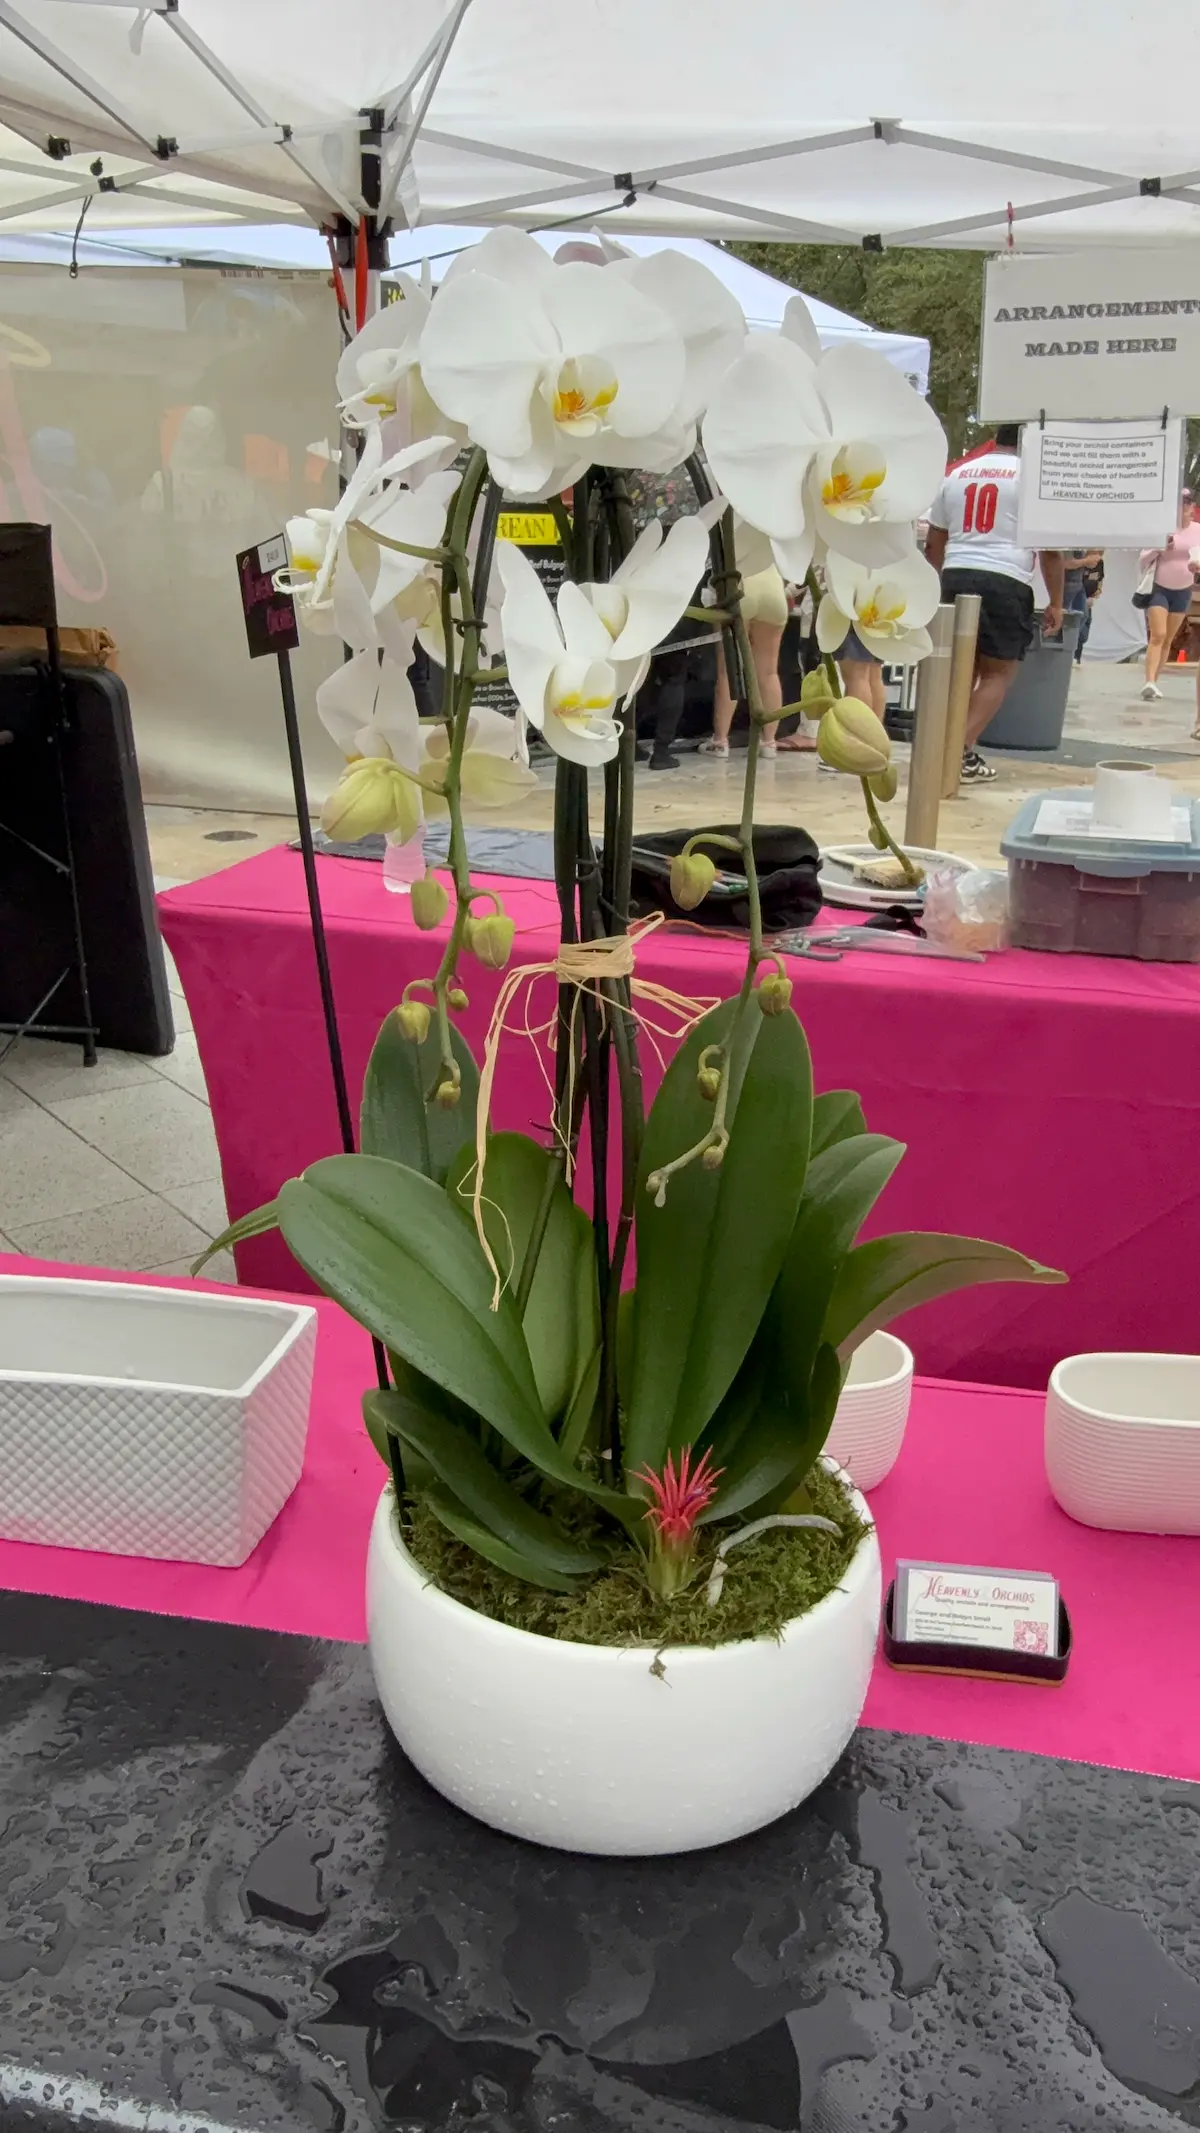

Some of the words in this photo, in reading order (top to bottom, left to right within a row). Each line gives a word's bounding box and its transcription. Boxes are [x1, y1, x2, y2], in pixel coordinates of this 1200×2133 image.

[994, 299, 1200, 322] ARRANGEMENT
[1024, 340, 1099, 357] MADE
[1106, 337, 1177, 354] HERE
[1044, 439, 1064, 448] Bring
[1087, 451, 1097, 459] fill
[1042, 459, 1077, 468] beautiful
[1106, 461, 1157, 470] arrangement
[958, 467, 1017, 479] BELLINGHAM
[1118, 471, 1158, 479] hundreds
[1053, 490, 1094, 499] HEAVENLY
[1096, 491, 1135, 500] ORCHIDS
[962, 482, 999, 534] 10
[498, 517, 546, 539] REAN
[543, 559, 565, 571] Bulgog
[992, 1586, 1035, 1604] ORCHIDS
